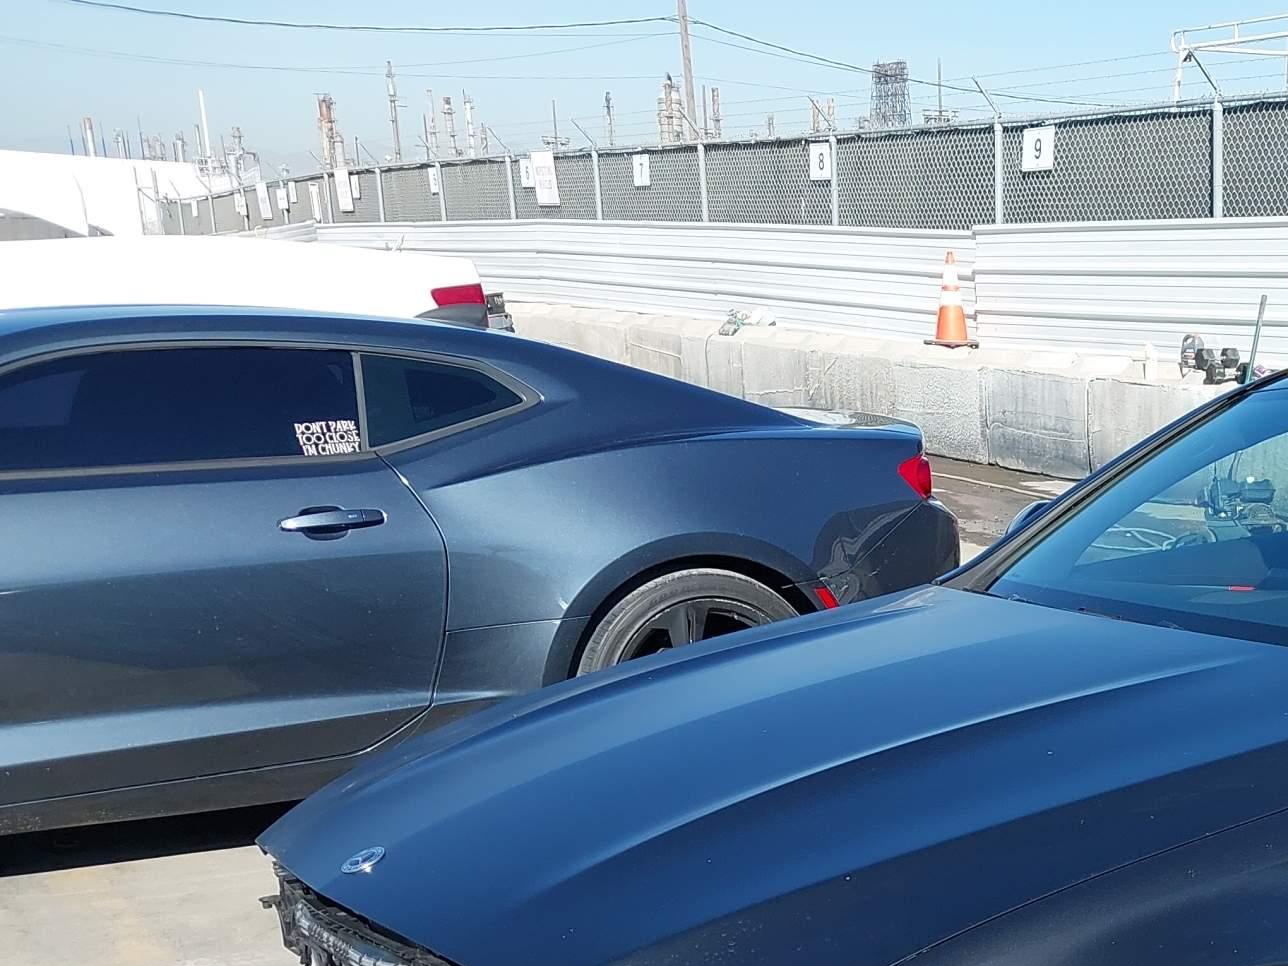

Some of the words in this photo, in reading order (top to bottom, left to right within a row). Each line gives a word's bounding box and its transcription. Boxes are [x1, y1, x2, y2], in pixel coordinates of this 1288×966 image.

[1034, 138, 1042, 159] 9
[818, 153, 825, 170] 8
[328, 420, 356, 432] PARK
[296, 432, 324, 445] TOO
[325, 430, 360, 443] CLOSE
[302, 444, 318, 456] I'M
[318, 441, 360, 456] CHUNKY
